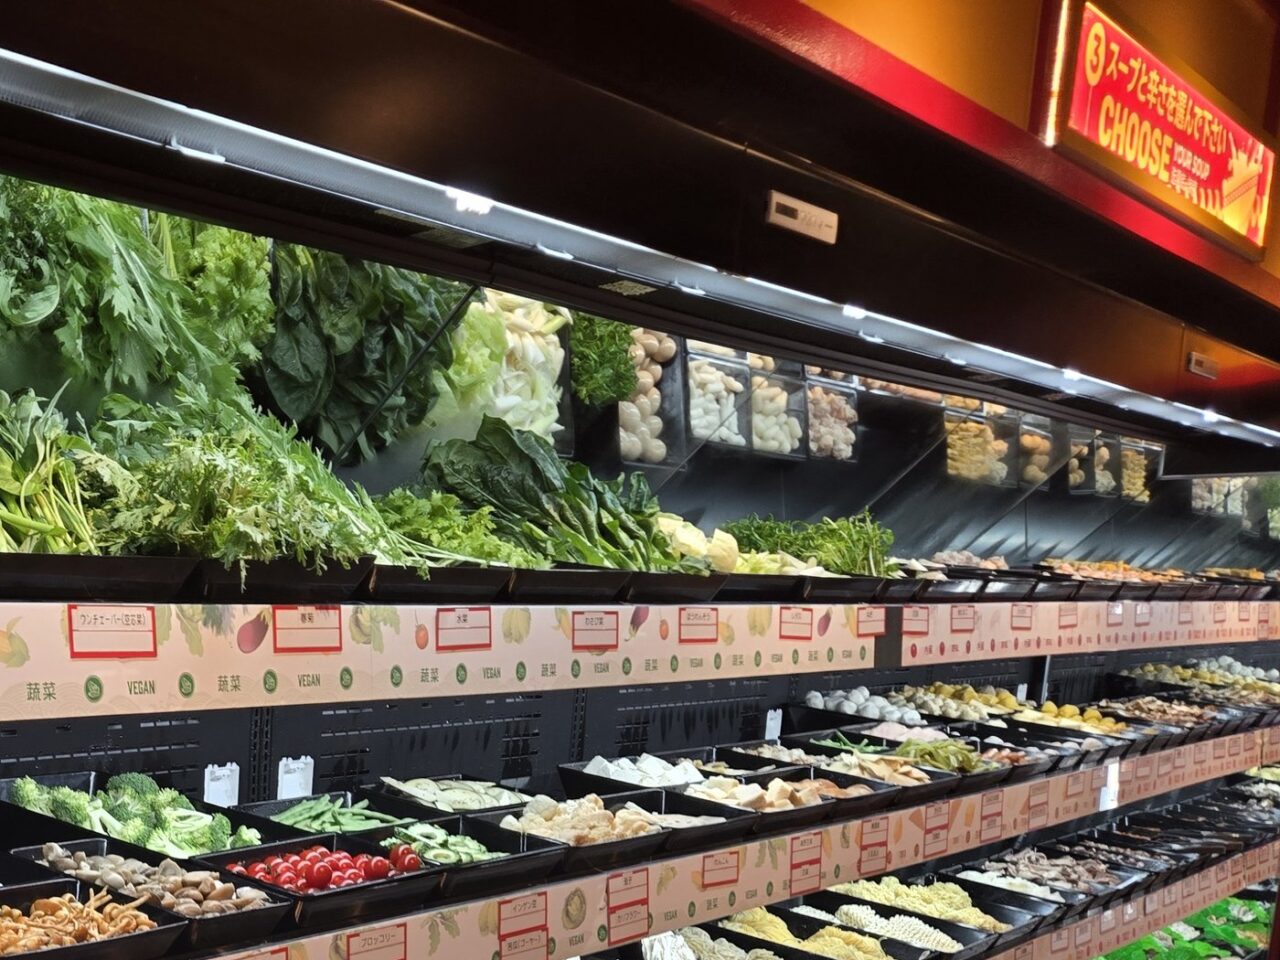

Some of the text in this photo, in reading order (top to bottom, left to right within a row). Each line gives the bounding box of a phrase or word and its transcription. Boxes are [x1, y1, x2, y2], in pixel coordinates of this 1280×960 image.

[1098, 95, 1174, 182] CHOOSE
[297, 674, 321, 687] VEGAN
[482, 668, 501, 679] VEGAN
[26, 682, 57, 701] 蔬菜
[127, 680, 156, 695] VEGAN
[217, 675, 241, 692] 蔬菜
